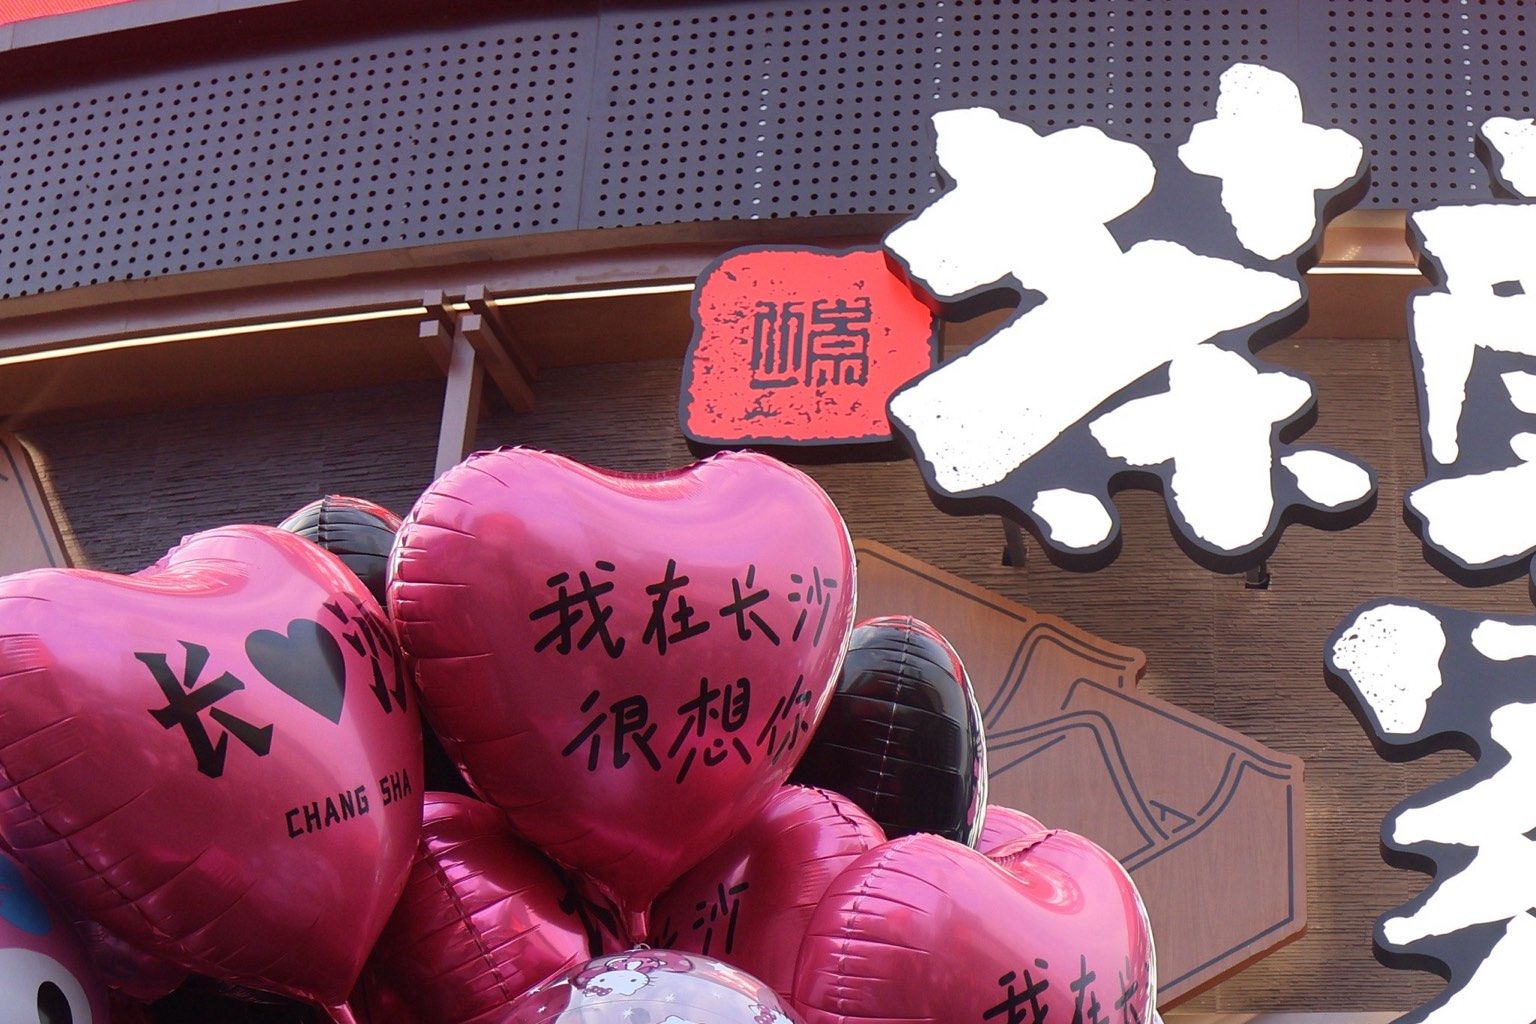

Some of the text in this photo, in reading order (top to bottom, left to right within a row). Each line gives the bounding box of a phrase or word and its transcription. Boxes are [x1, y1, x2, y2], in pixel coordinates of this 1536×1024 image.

[529, 559, 838, 659] 我在长沙
[562, 673, 812, 785] 很想你
[285, 768, 412, 839] CHANG SHA
